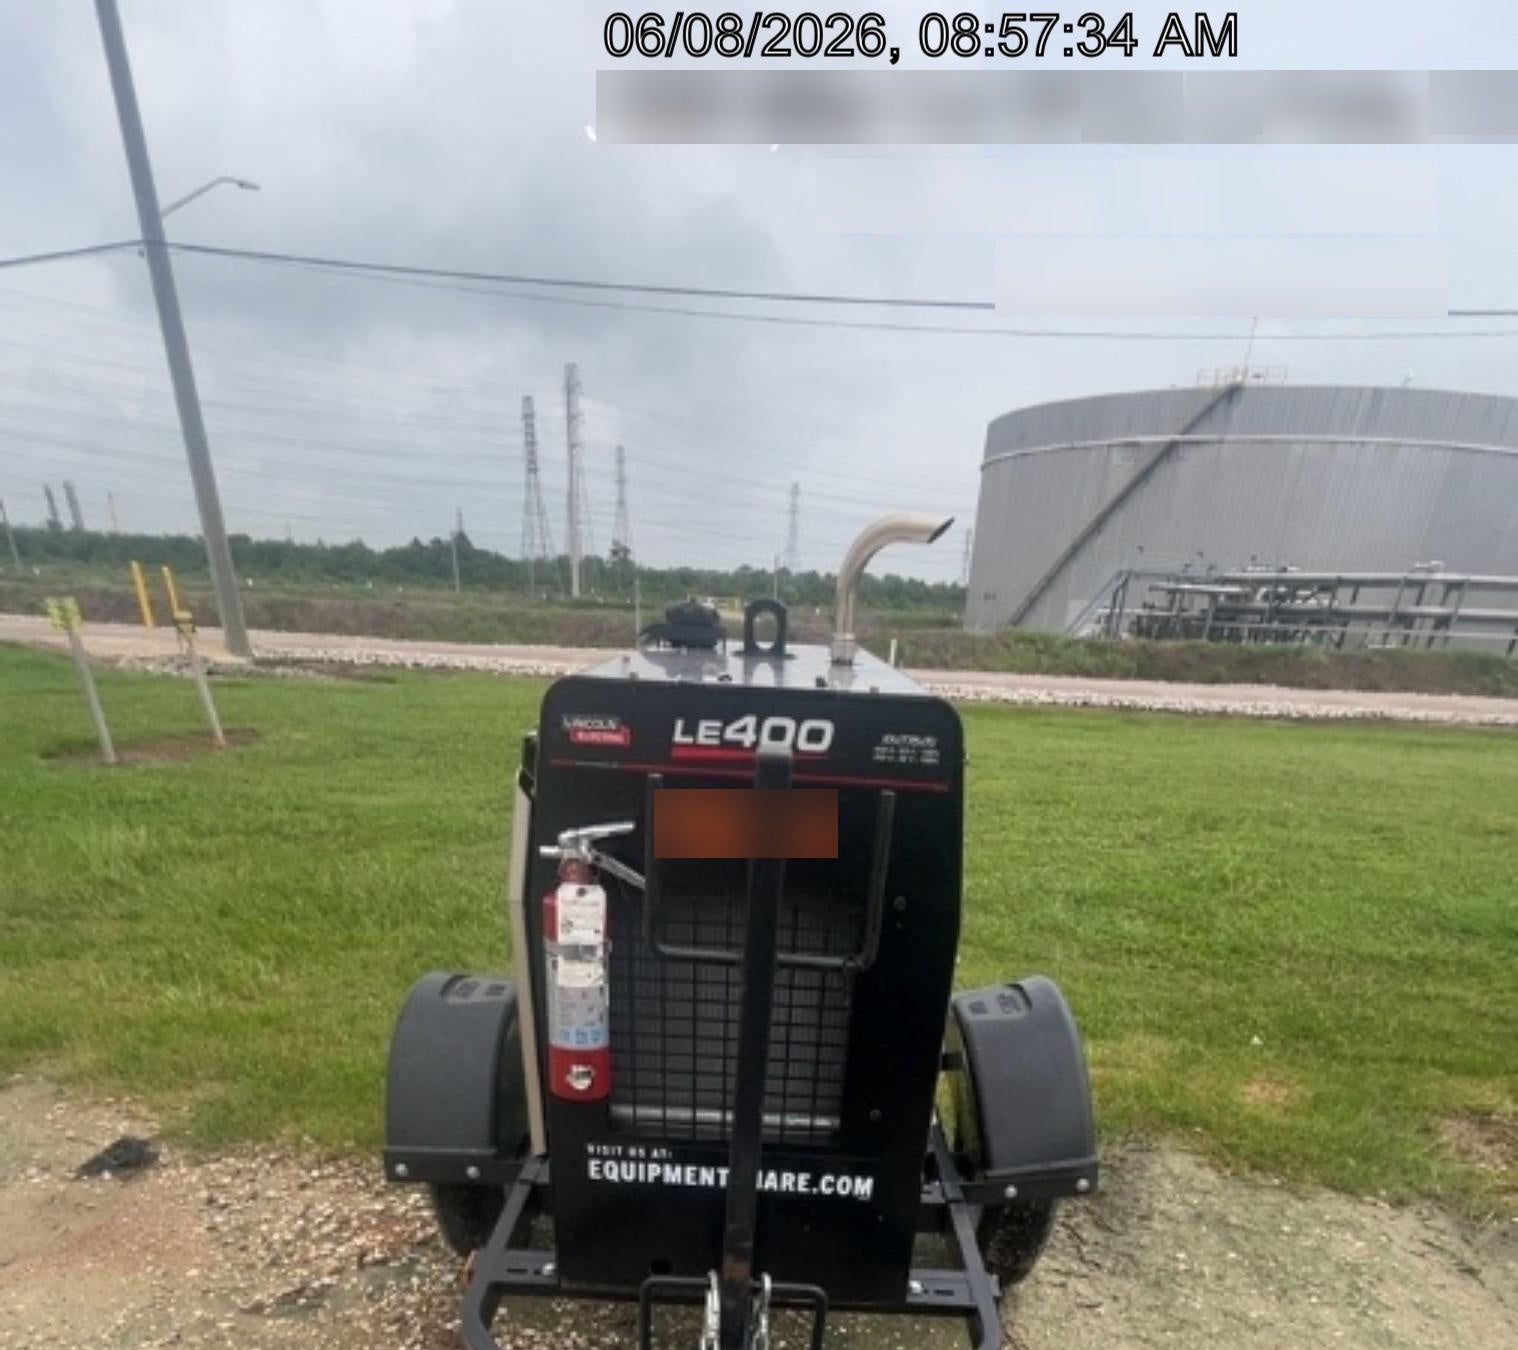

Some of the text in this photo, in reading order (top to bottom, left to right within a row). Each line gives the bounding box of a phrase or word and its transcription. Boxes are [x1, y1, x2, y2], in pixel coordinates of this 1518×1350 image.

[672, 714, 834, 752] LE400
[587, 1143, 623, 1156] VISIT
[588, 1158, 875, 1198] EQUIPMENTARE.COM
